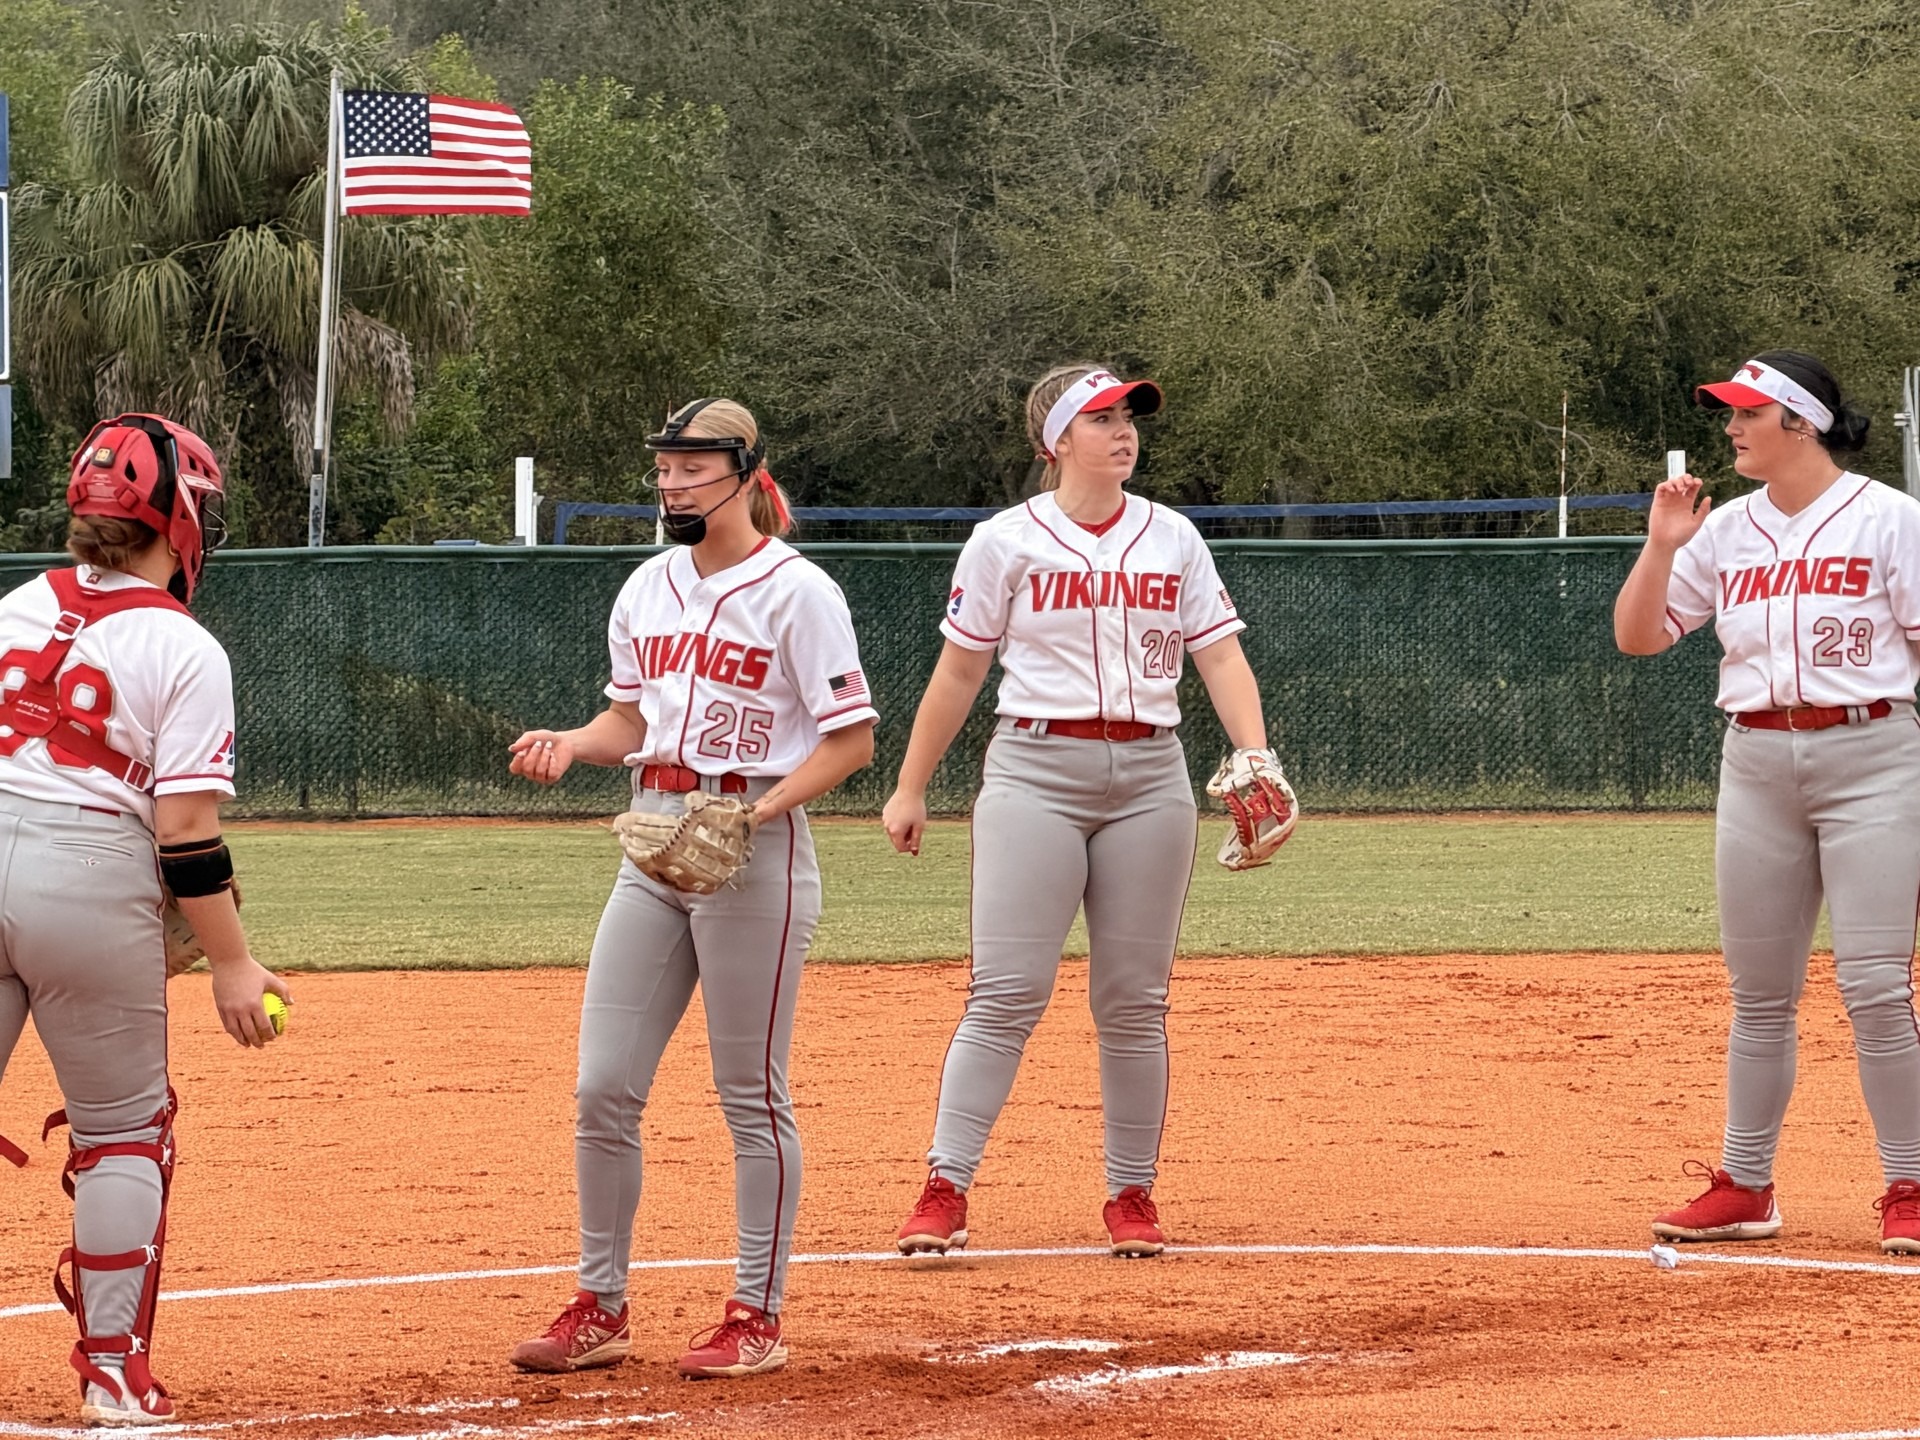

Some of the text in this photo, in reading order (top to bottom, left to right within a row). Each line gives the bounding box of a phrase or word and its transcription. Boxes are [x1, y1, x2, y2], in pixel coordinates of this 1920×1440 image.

[1029, 571, 1181, 613] VIKINGS
[1719, 556, 1873, 612] VIKINGS
[631, 632, 774, 691] VIKINGS
[1141, 629, 1182, 679] 20
[1812, 616, 1874, 667] 23
[697, 700, 774, 763] 25
